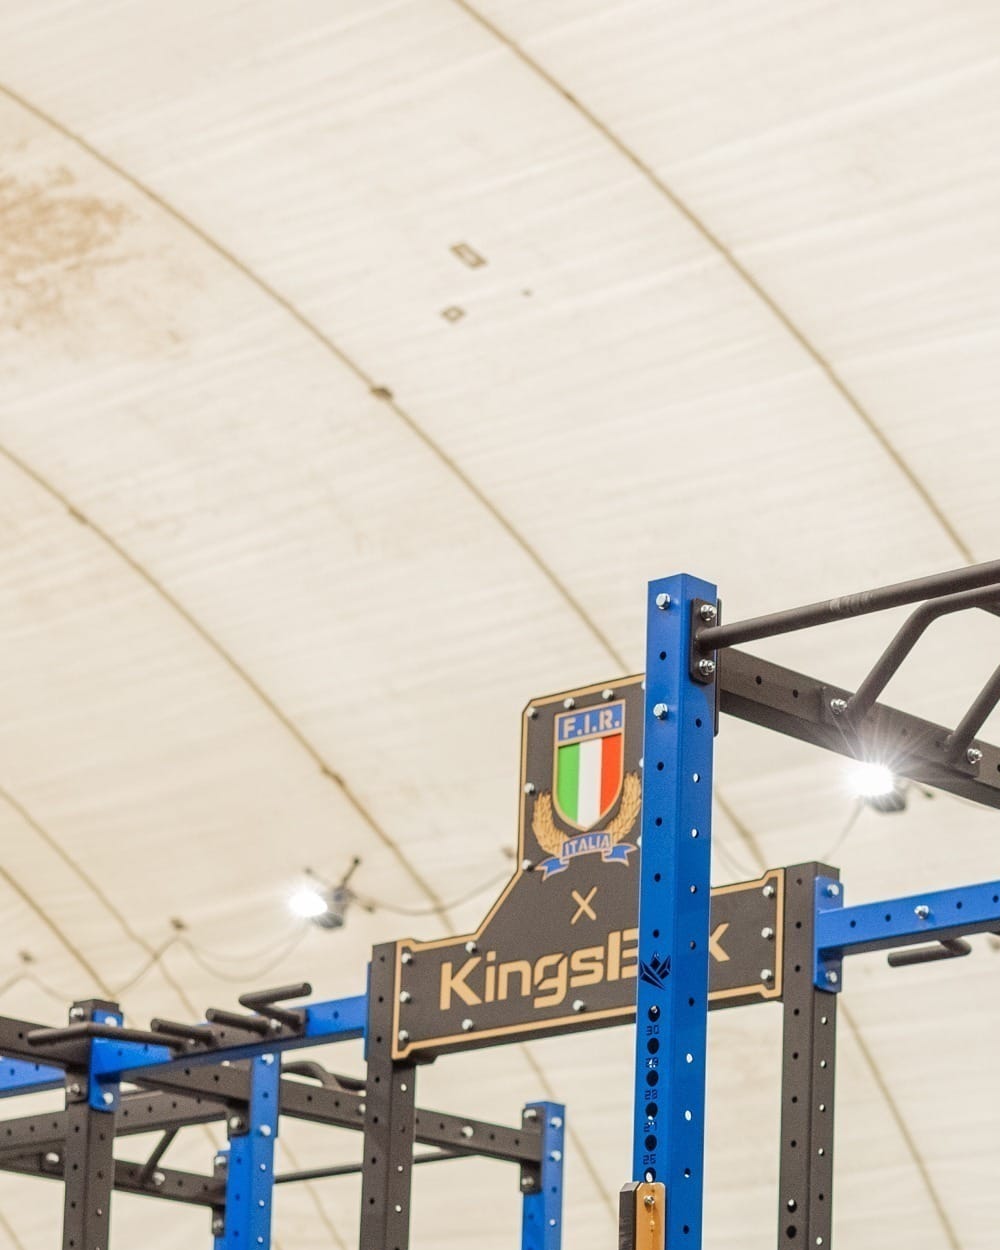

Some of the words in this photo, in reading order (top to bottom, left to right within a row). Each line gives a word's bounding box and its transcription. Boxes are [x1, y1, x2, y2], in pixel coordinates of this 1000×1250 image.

[563, 712, 620, 739] F.I.R.
[563, 833, 611, 855] ITALIA
[440, 922, 731, 1010] KingsBx
